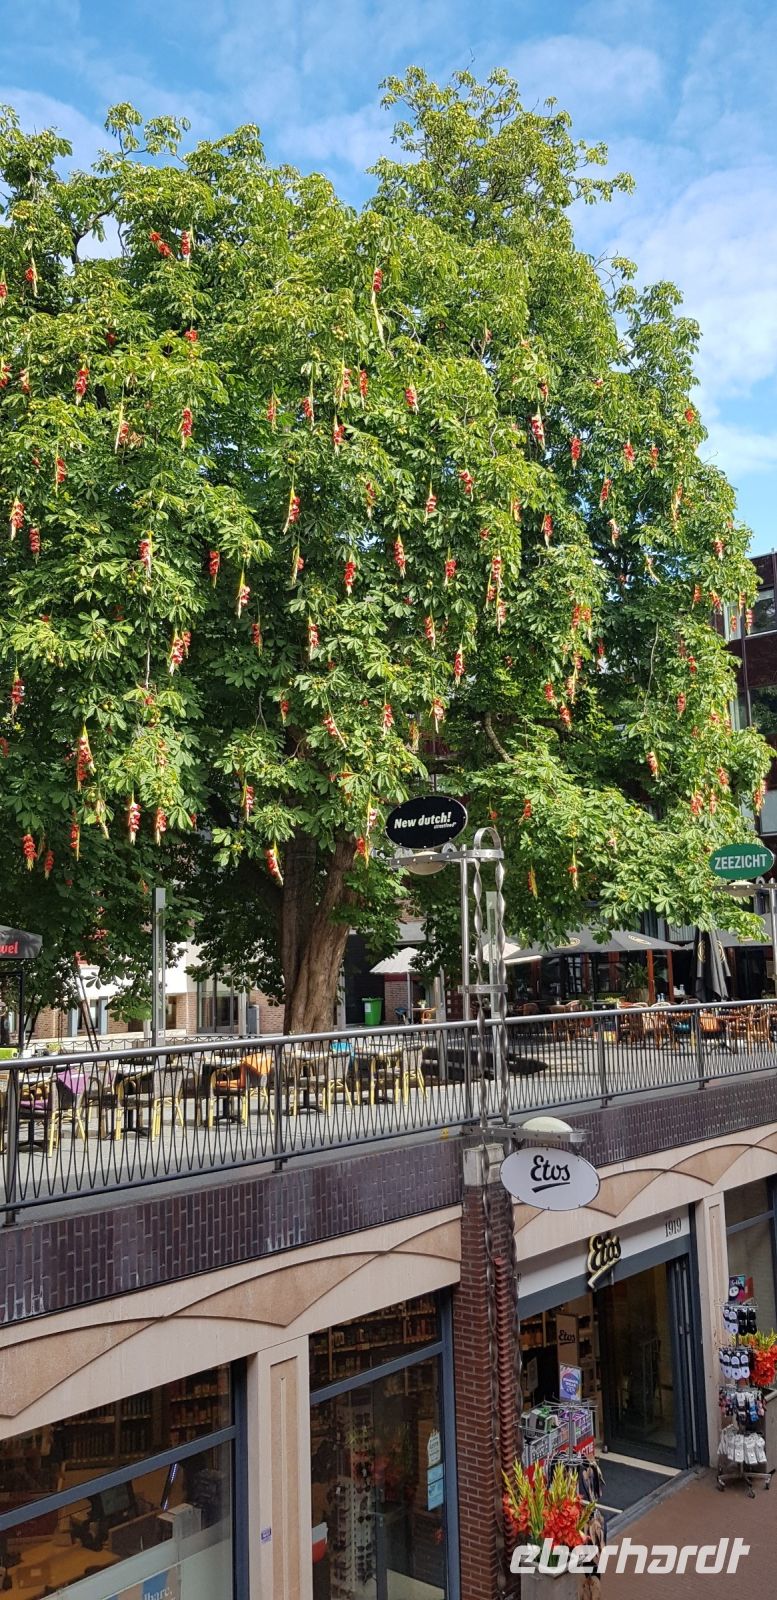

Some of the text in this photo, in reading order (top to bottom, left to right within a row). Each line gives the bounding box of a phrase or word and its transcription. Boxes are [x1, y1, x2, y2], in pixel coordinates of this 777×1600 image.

[394, 811, 452, 829] New dutch!
[714, 853, 767, 870] ZEEZICHT
[530, 1154, 571, 1182] Etos
[664, 1217, 682, 1238] 1919
[587, 1234, 622, 1272] Etos
[558, 1329, 576, 1342] Etos
